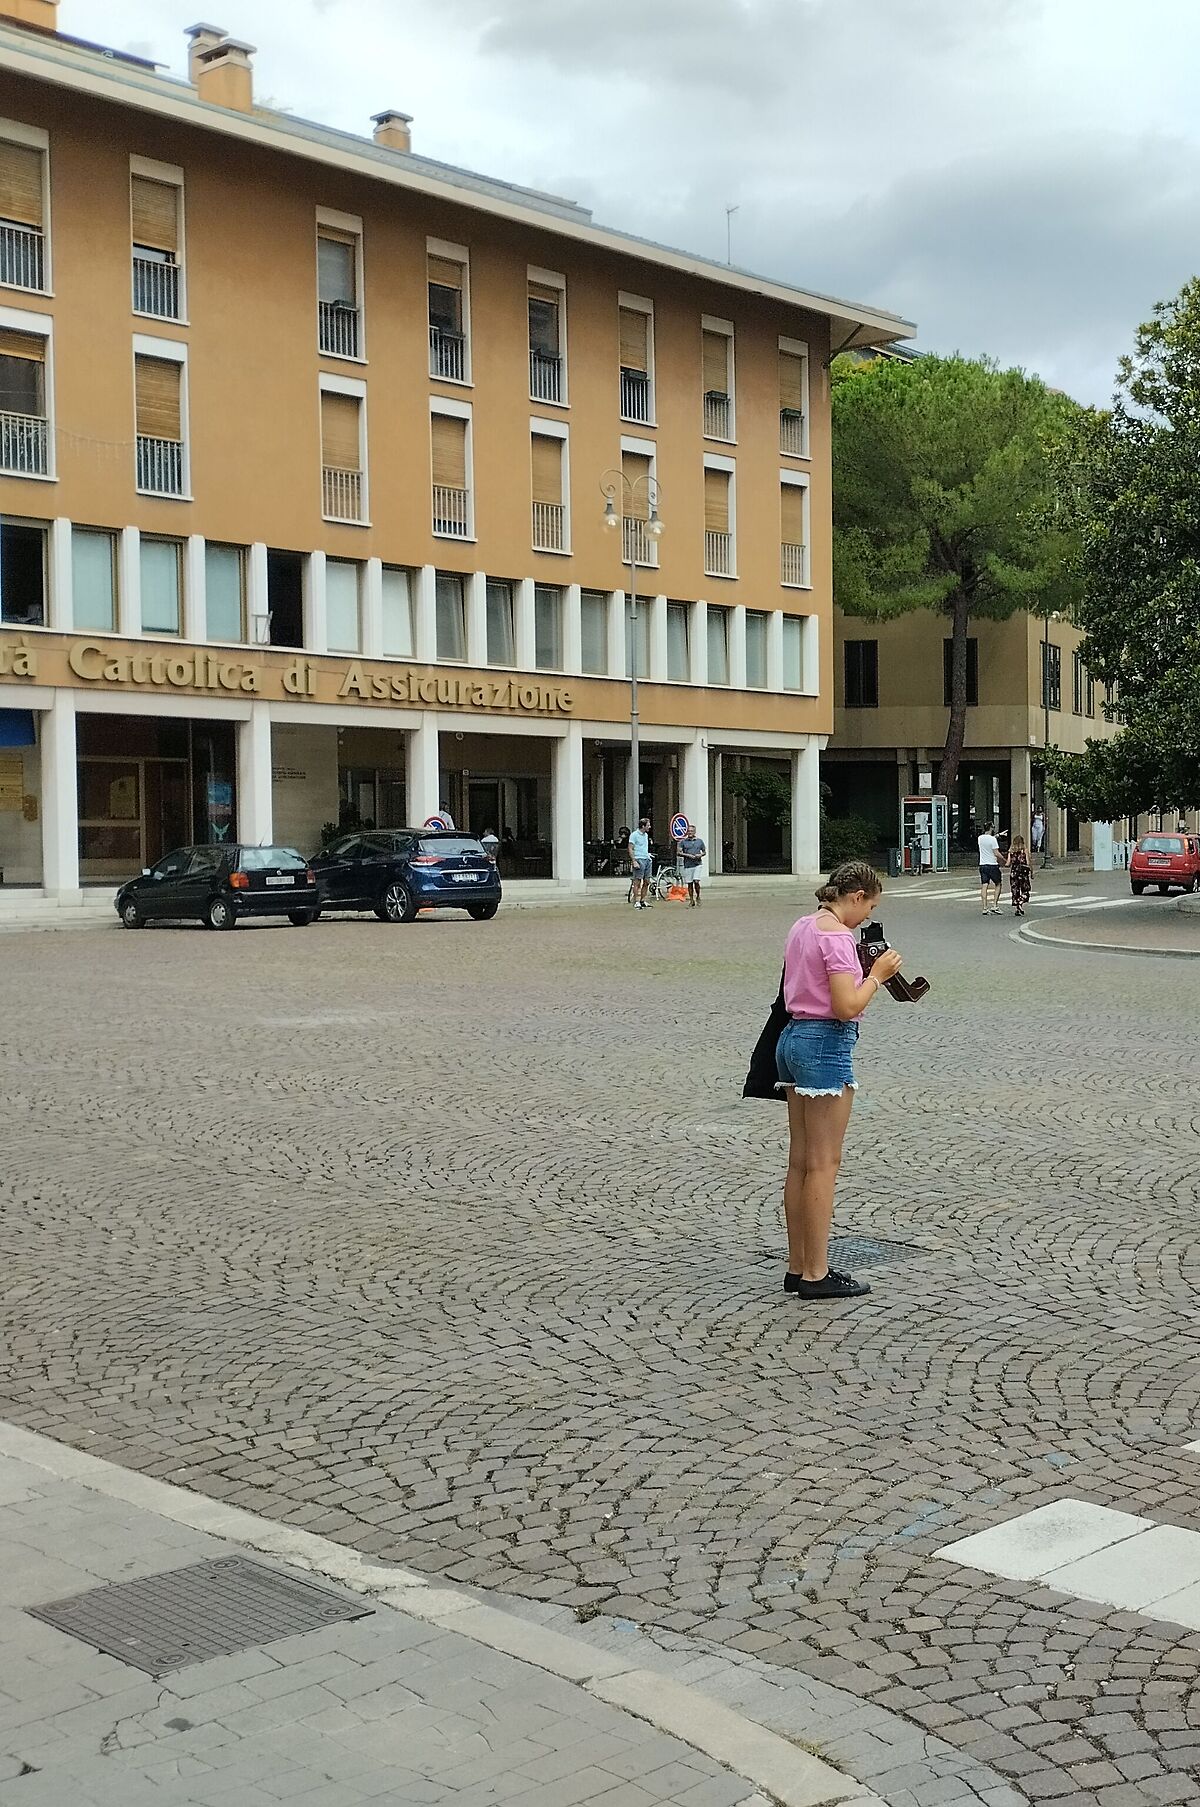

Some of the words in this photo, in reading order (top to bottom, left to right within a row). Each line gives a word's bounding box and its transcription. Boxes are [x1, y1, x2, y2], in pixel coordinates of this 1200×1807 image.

[68, 639, 261, 692] Cattolica
[282, 657, 318, 696] di
[336, 661, 577, 713] Assicurazione
